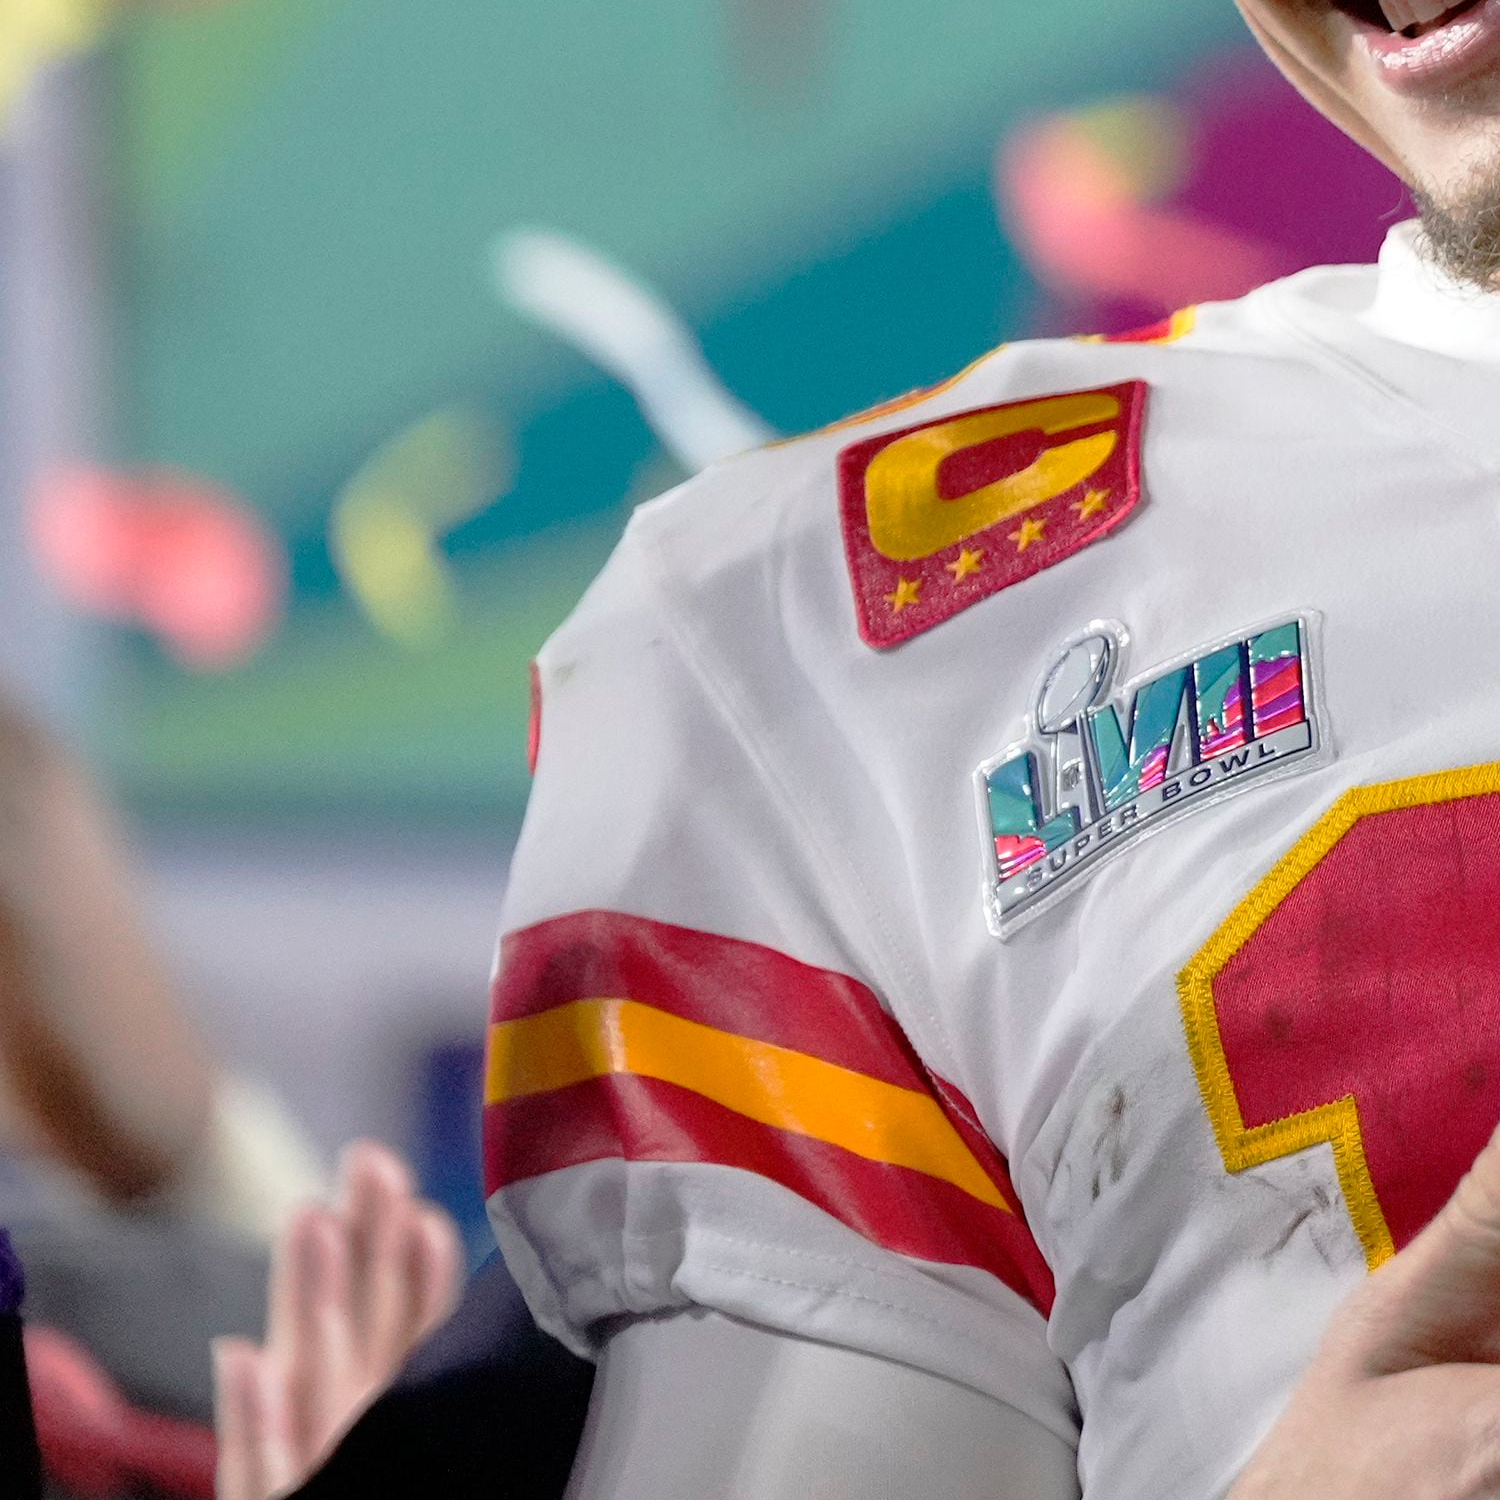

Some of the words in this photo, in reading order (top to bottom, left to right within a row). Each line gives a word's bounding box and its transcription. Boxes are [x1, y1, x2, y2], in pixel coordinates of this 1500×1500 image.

[865, 394, 1120, 562] C
[1025, 803, 1141, 888] SUPER
[1161, 742, 1277, 802] BOWL
